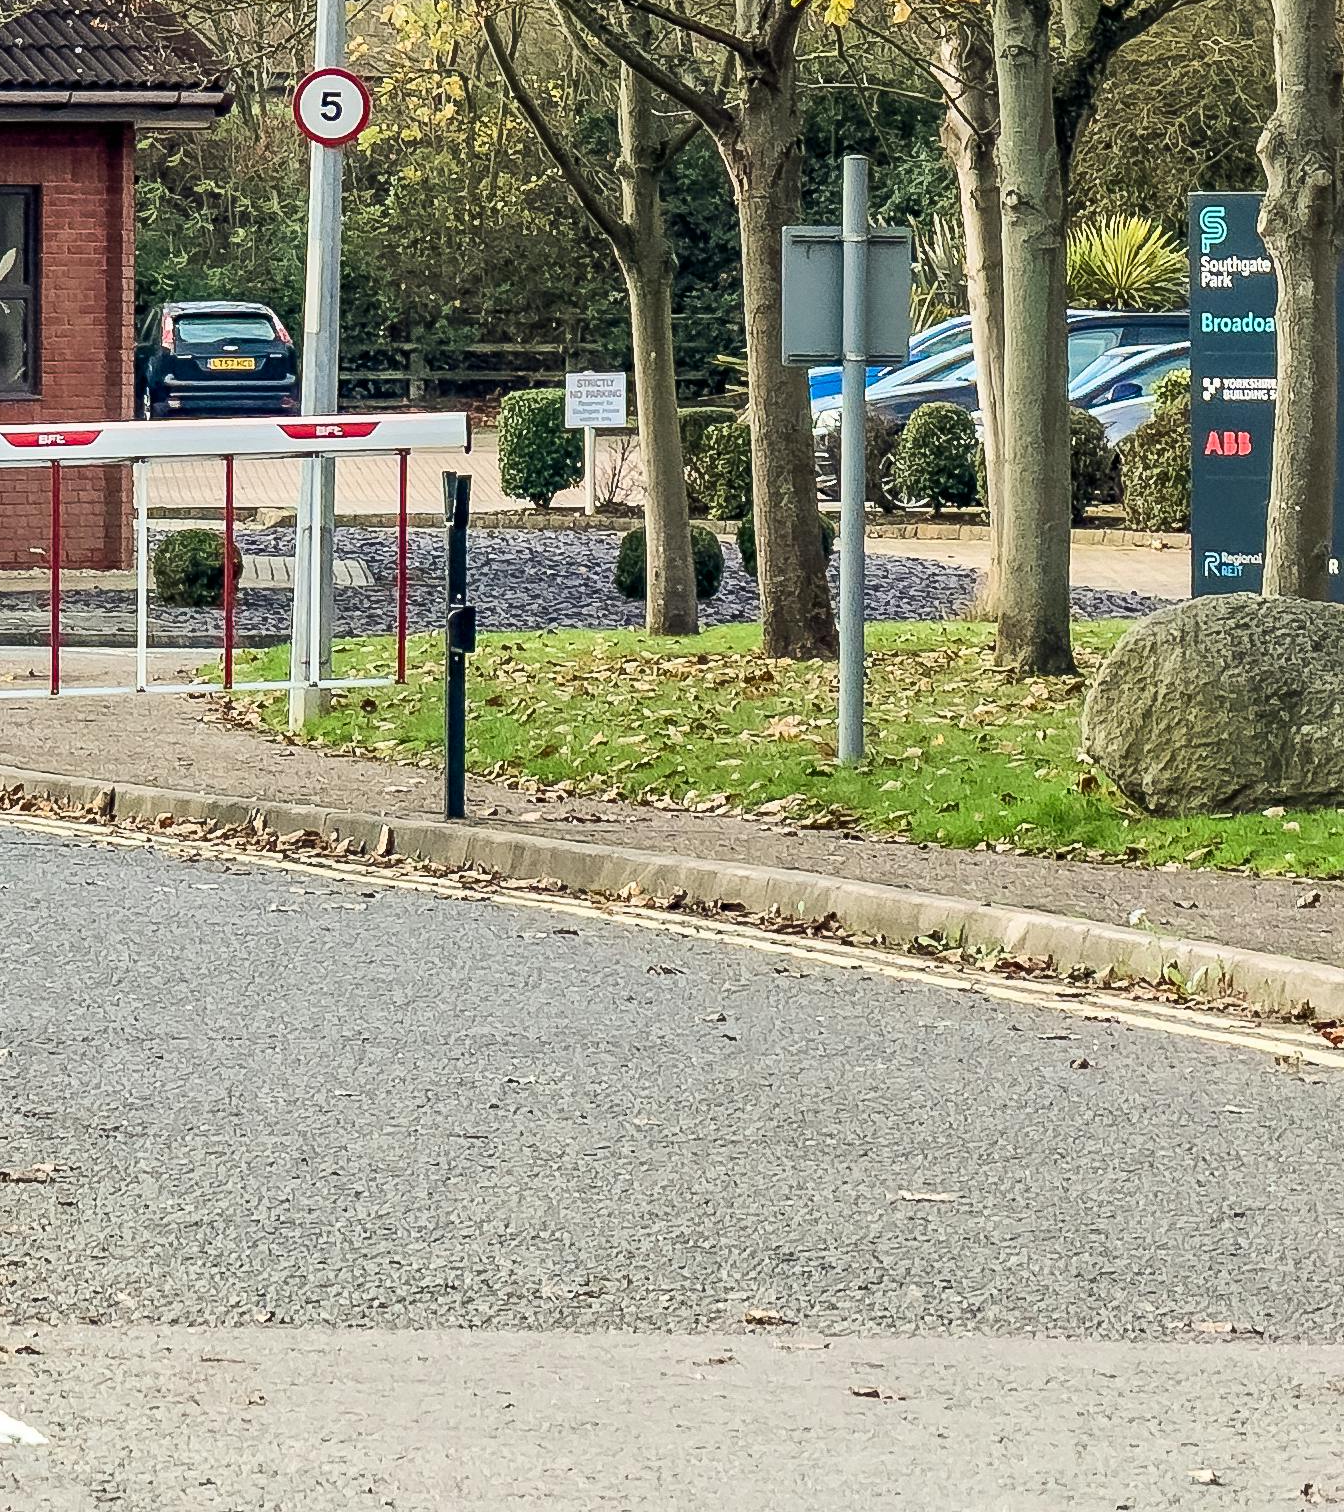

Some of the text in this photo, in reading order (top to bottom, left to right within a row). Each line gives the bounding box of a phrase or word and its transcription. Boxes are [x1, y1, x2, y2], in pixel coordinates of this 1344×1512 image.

[320, 91, 343, 122] 5
[1200, 255, 1272, 277] Southgate
[1201, 271, 1233, 288] Park
[577, 379, 614, 388] STRICTLY
[569, 389, 622, 399] NO PARKING
[1222, 389, 1269, 401] BUILDING
[1204, 430, 1252, 456] ABB
[1221, 551, 1263, 566] Regional
[1221, 565, 1243, 577] REIT
